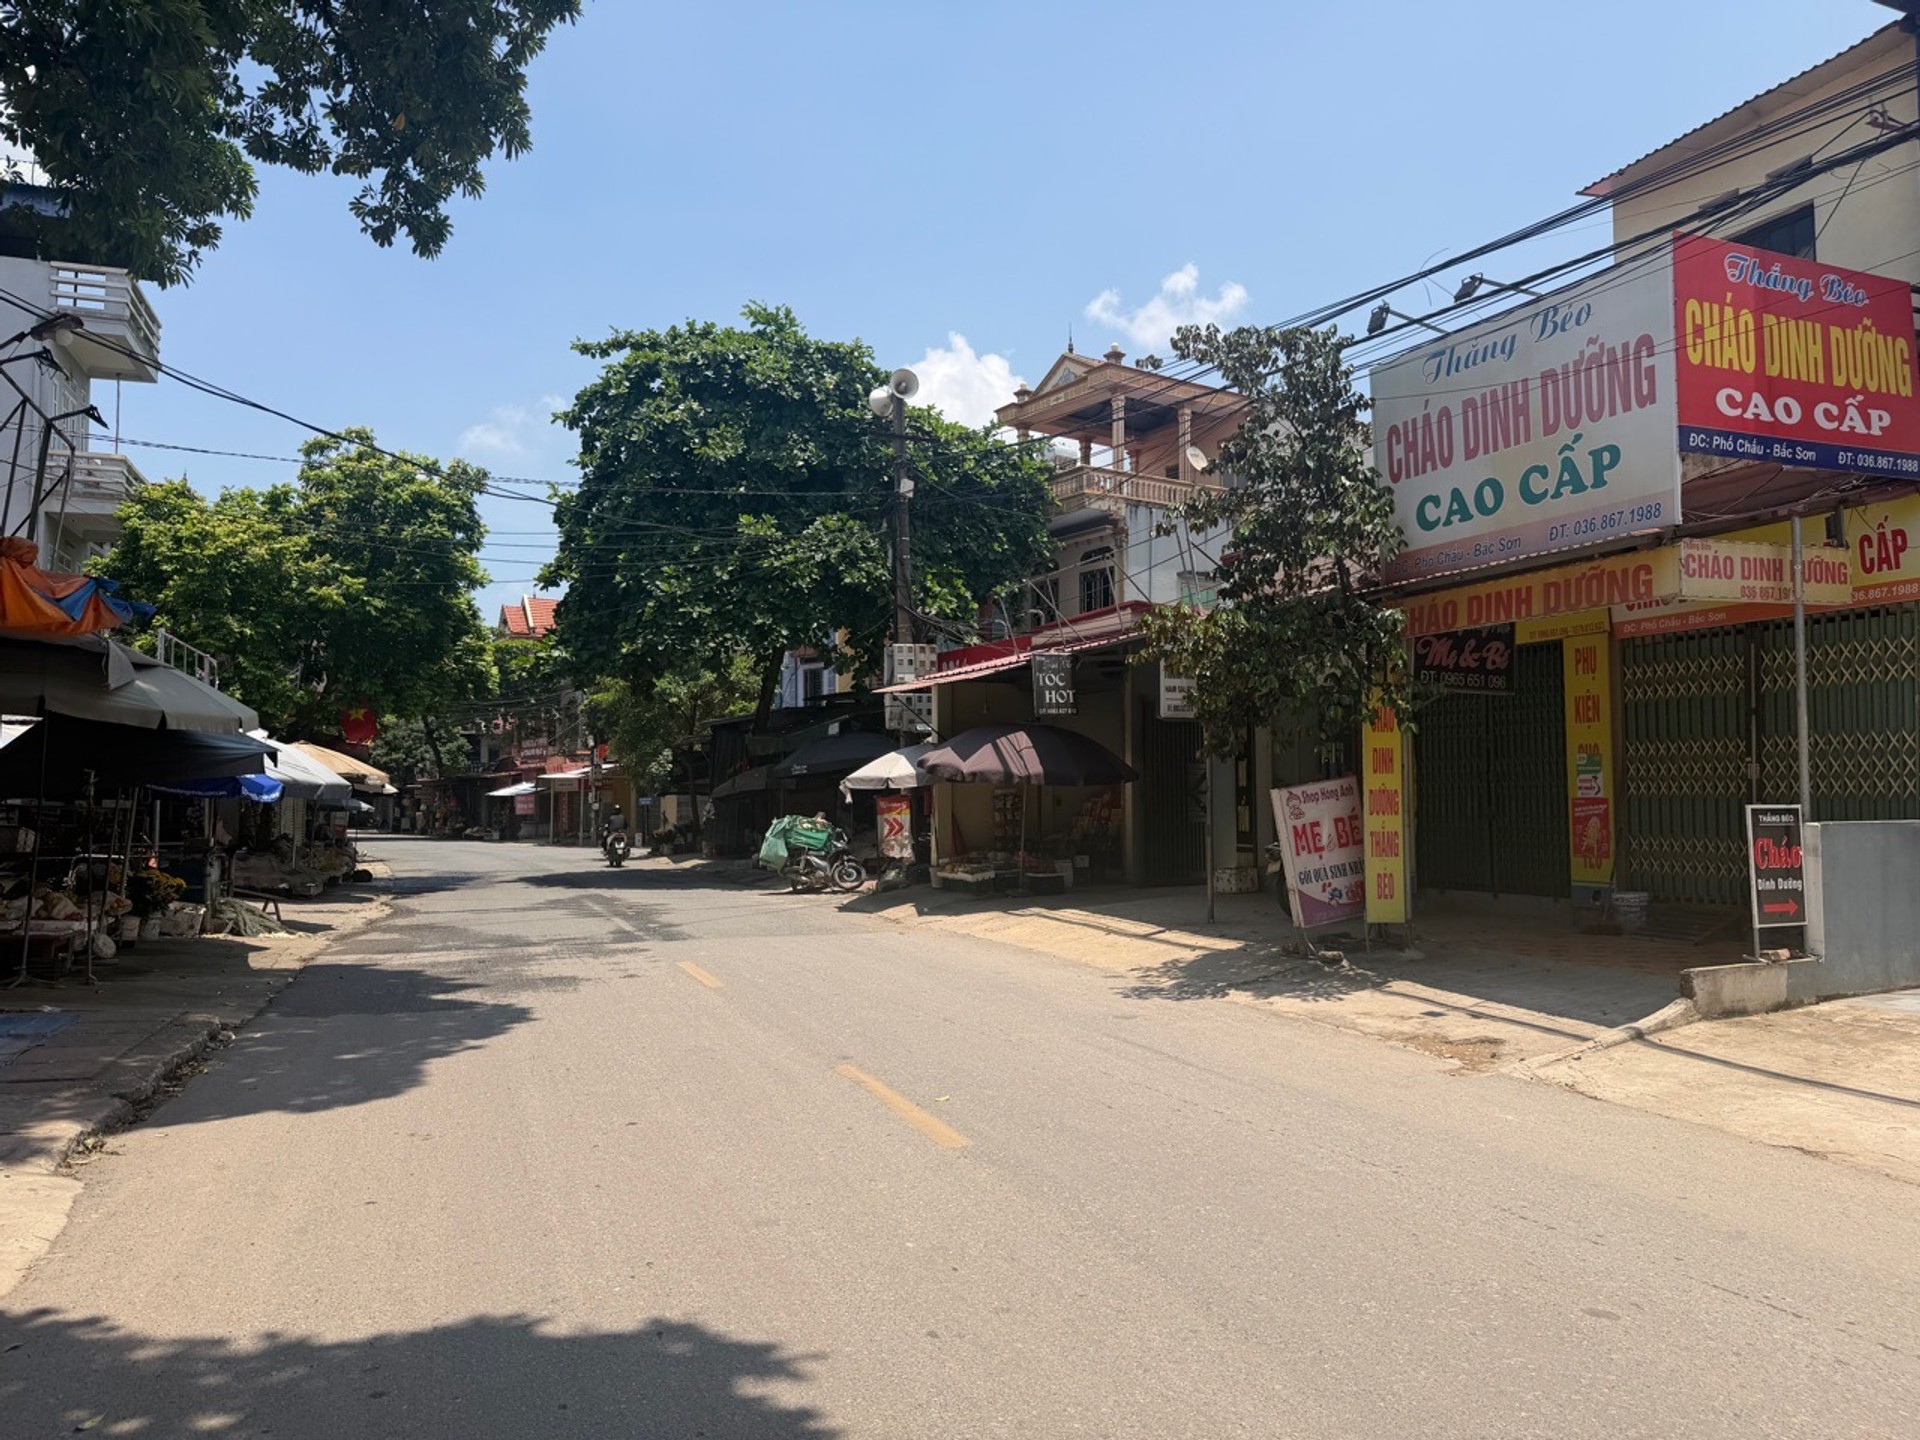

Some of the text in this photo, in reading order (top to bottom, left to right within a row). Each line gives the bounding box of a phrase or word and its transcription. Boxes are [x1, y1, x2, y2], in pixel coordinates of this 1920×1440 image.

[1820, 274, 1869, 307] Béo
[1530, 302, 1595, 343] Béo
[1685, 292, 1913, 397] CHÁO DINH DƯỠNG
[1387, 333, 1657, 485] CHÁO DINH DƯỠNG
[1715, 387, 1892, 436] CAO CẤP
[1689, 433, 1710, 449] ĐC:
[1712, 435, 1734, 451] Phố
[1773, 442, 1793, 458] Bắc
[1795, 446, 1817, 462] Sơn
[1838, 451, 1919, 473] ĐT: 036.867.1988
[1416, 433, 1622, 532] CAO CẤP
[1549, 502, 1663, 542] ĐT: 036.867.1988
[1858, 515, 1908, 575] CẤP
[1684, 551, 1734, 580] CHÁO
[1740, 556, 1784, 582] DINH
[1466, 585, 1533, 627] DINH
[1542, 566, 1653, 614] DƯỠNG
[1574, 645, 1597, 680] PHỤ
[1044, 689, 1076, 704] HOT
[1574, 689, 1600, 730] KIỆN
[1372, 747, 1395, 775] DINH
[1301, 790, 1319, 805] Shop
[1368, 782, 1400, 816] DƯỠNG
[1292, 820, 1326, 861] MẸ
[1333, 806, 1364, 849] BÉ
[1754, 835, 1803, 870] Cháo
[1376, 866, 1395, 900] BÉO
[1757, 877, 1776, 891] Dinh
